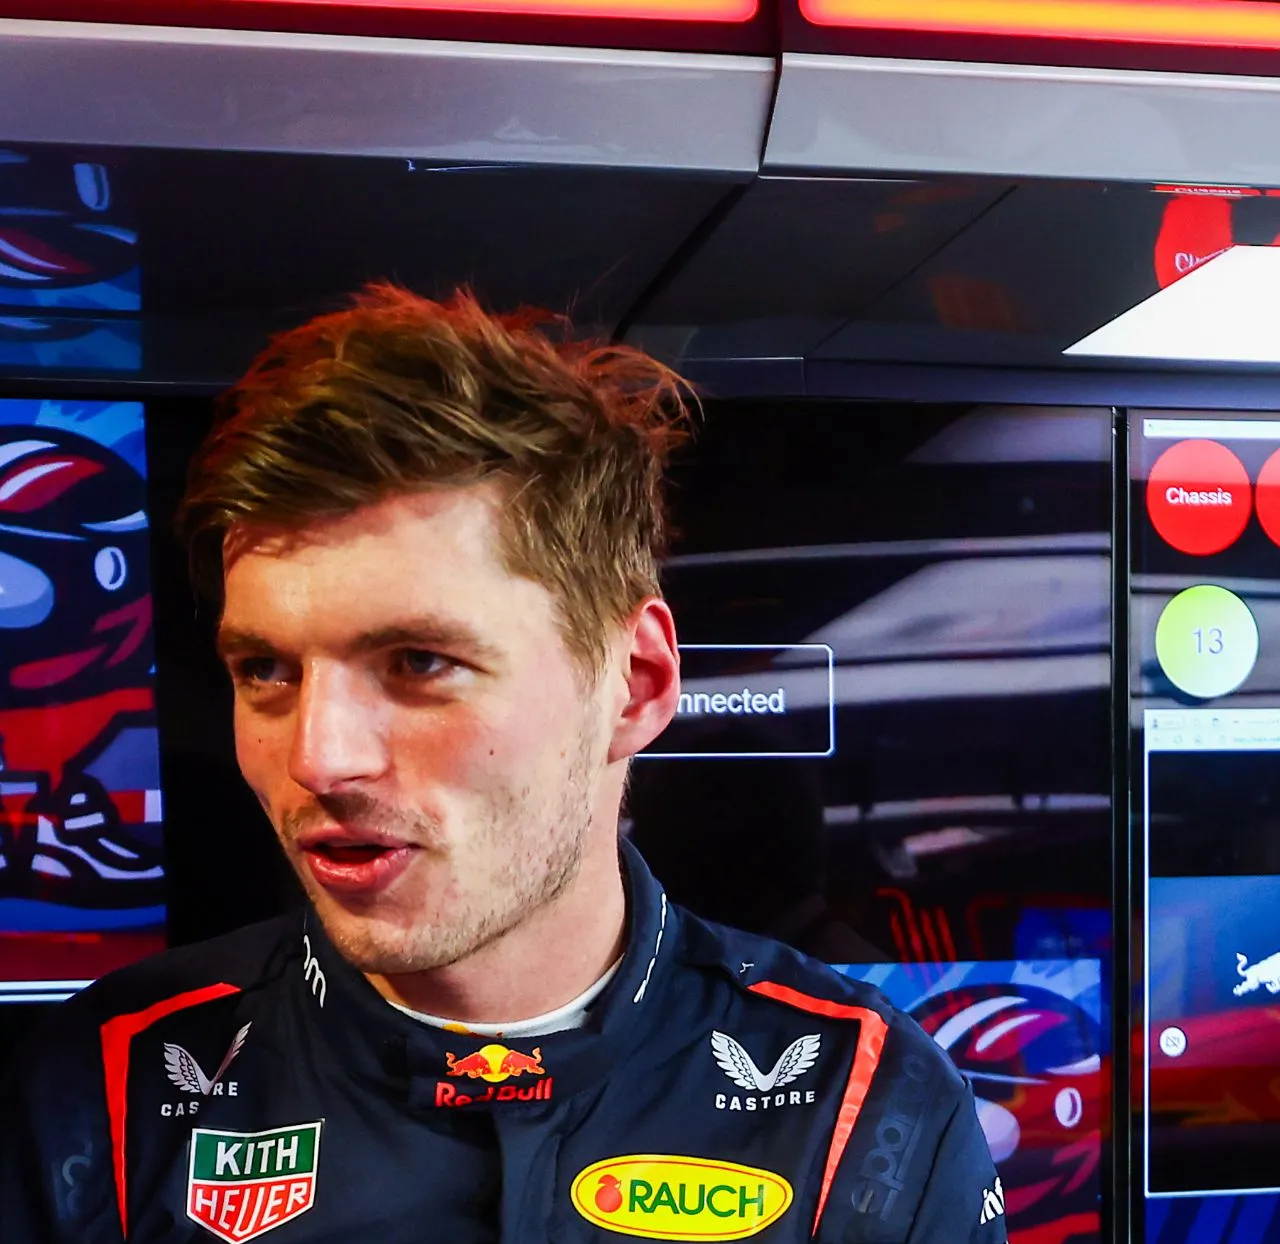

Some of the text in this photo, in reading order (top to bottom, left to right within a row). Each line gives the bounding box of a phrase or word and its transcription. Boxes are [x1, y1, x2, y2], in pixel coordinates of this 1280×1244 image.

[1166, 486, 1232, 505] Chassis
[1192, 627, 1224, 655] 13
[676, 689, 784, 714] nnected
[161, 1081, 237, 1116] CASRE
[715, 1090, 816, 1112] CASTORE
[215, 1137, 299, 1176] KITH
[194, 1180, 308, 1233] HEUER
[628, 1179, 764, 1218] RAUCH
